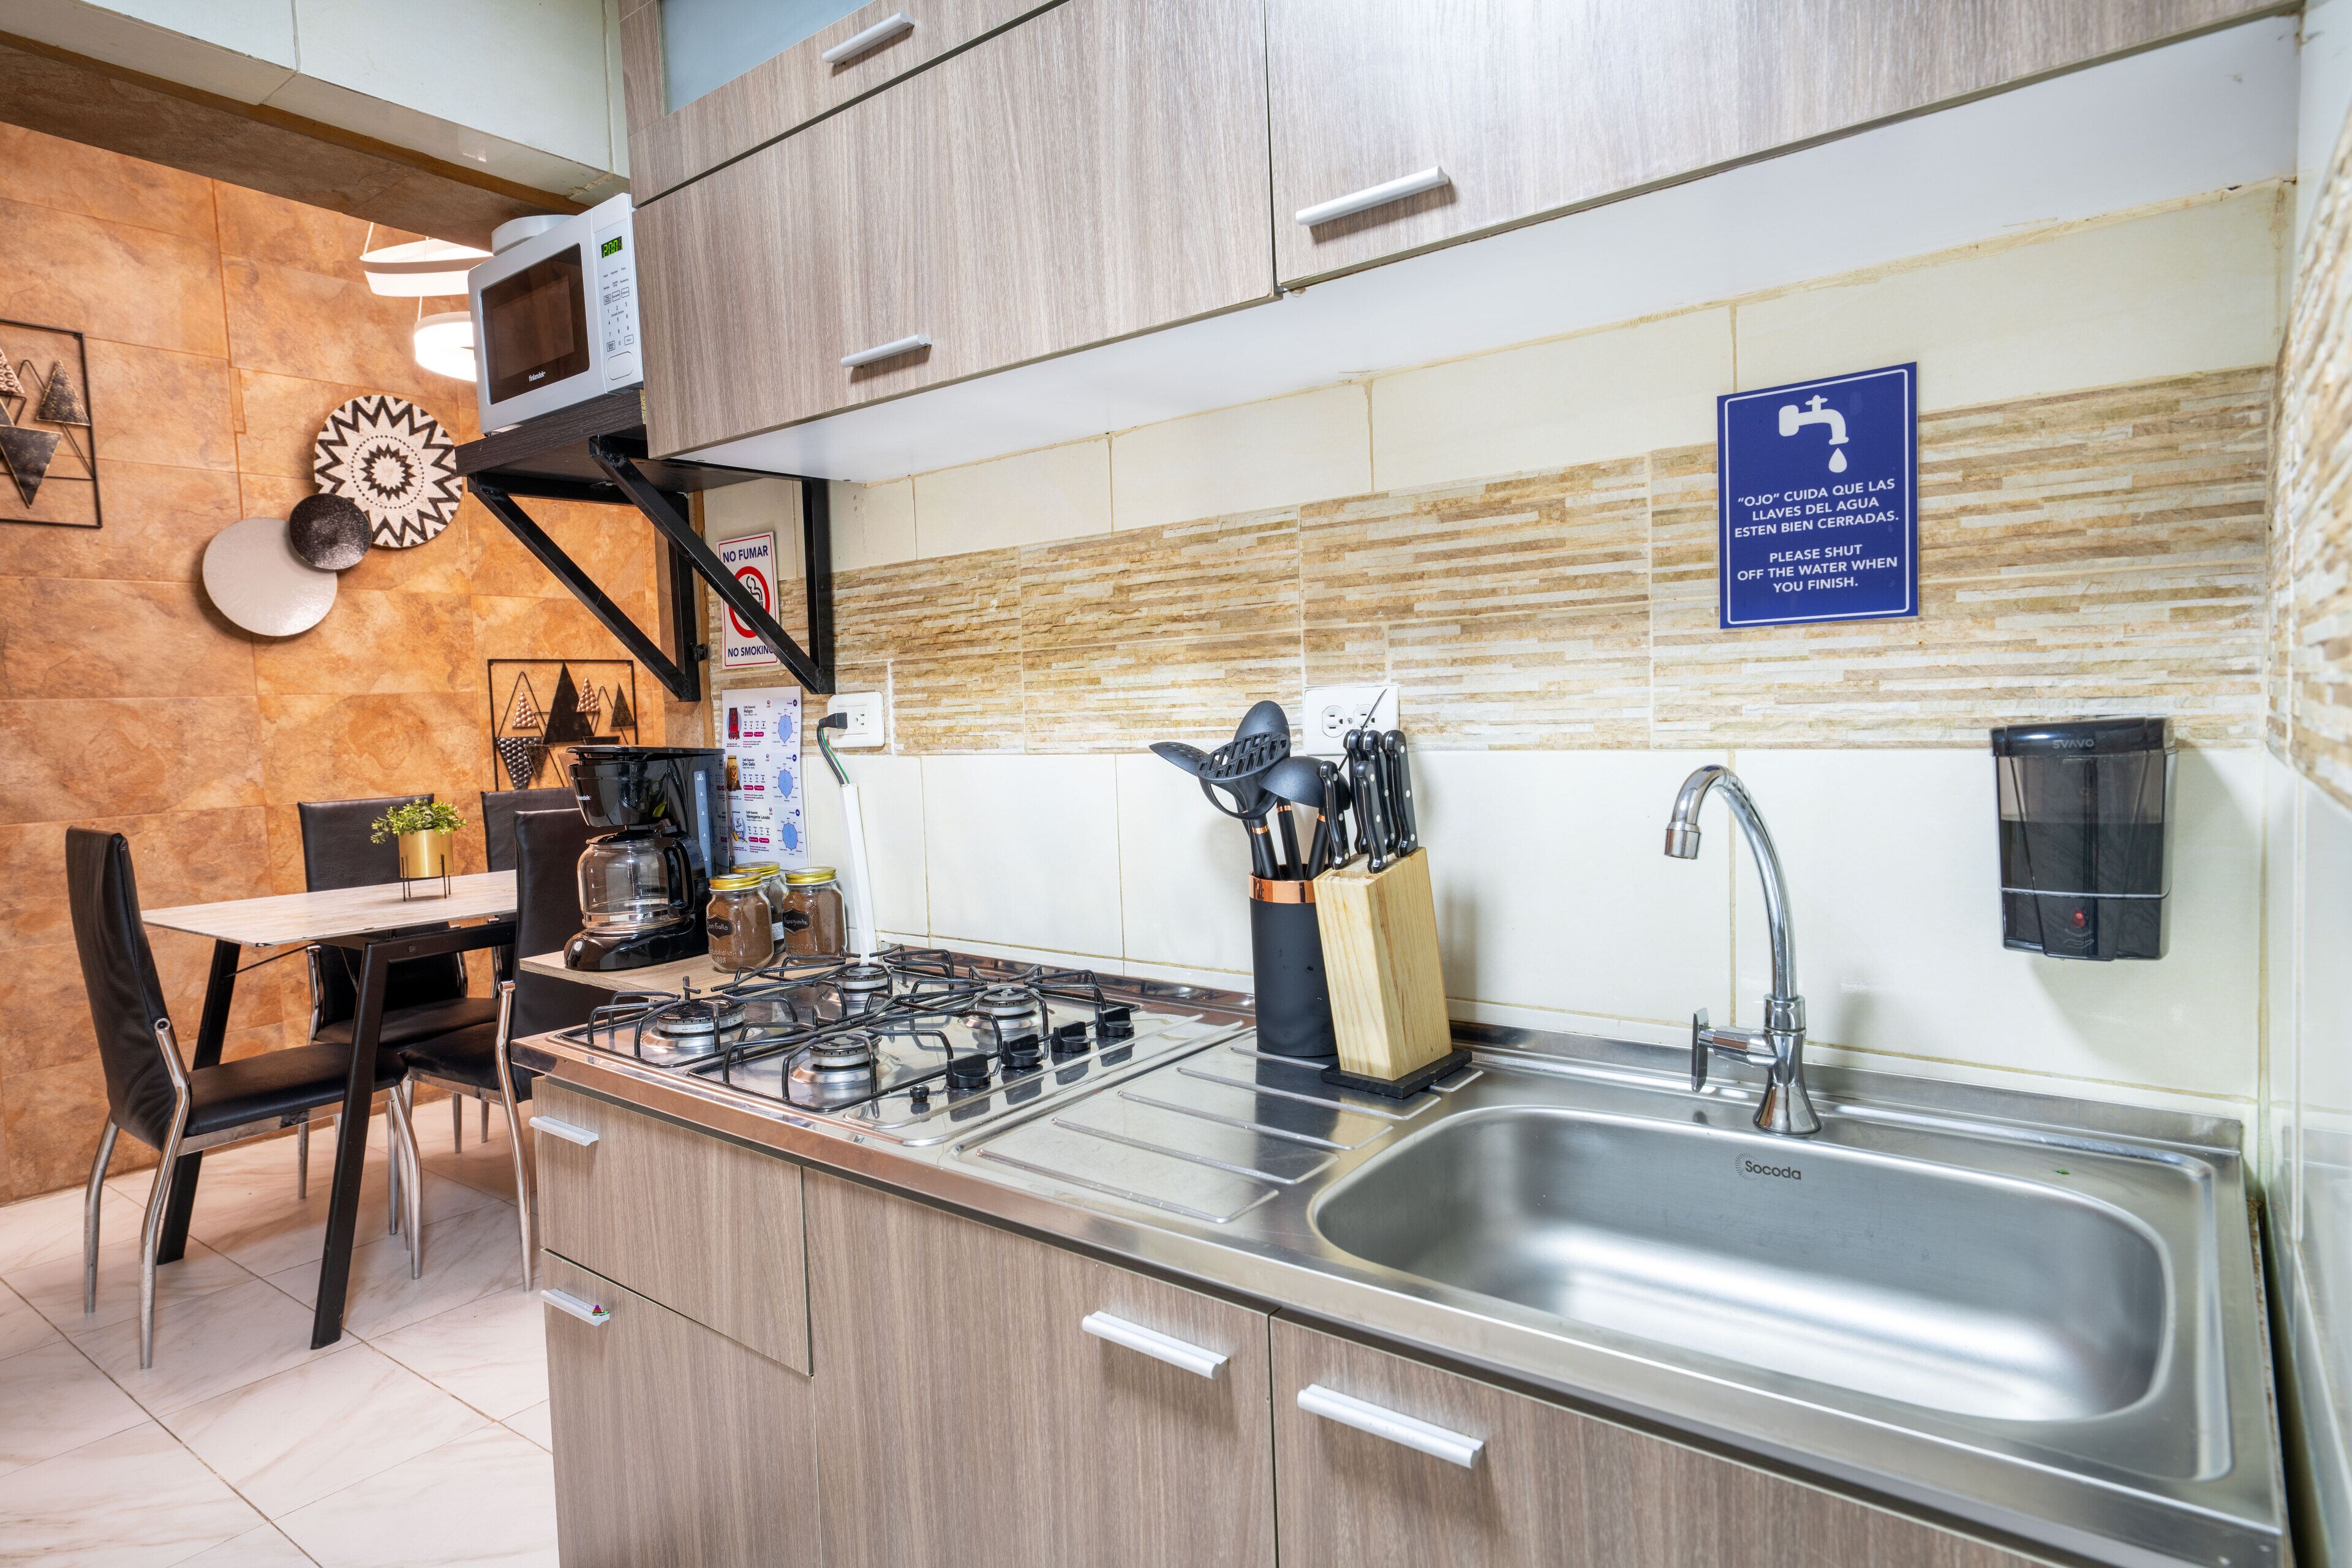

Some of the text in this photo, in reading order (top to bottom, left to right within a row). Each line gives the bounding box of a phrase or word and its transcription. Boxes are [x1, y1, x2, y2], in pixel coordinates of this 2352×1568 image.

[1784, 487, 1828, 502] CUIDA
[1833, 482, 1864, 496] QUE
[1869, 478, 1895, 492] LAS
[1752, 497, 1879, 521] LLAVES DEL AGUA
[1735, 510, 1899, 538] ESTEN BIEN CERRADAS.
[723, 545, 768, 563] NO FUMAR
[1770, 544, 1863, 563] PLEASE SHUT
[1737, 556, 1898, 581] OFF THE WATER WHEN
[1773, 576, 1858, 593] YOU FINISH.
[728, 647, 739, 657] NO
[2052, 739, 2094, 749] SVAVO
[783, 915, 809, 926] Navegante
[1745, 1160, 1802, 1180] Socoda
